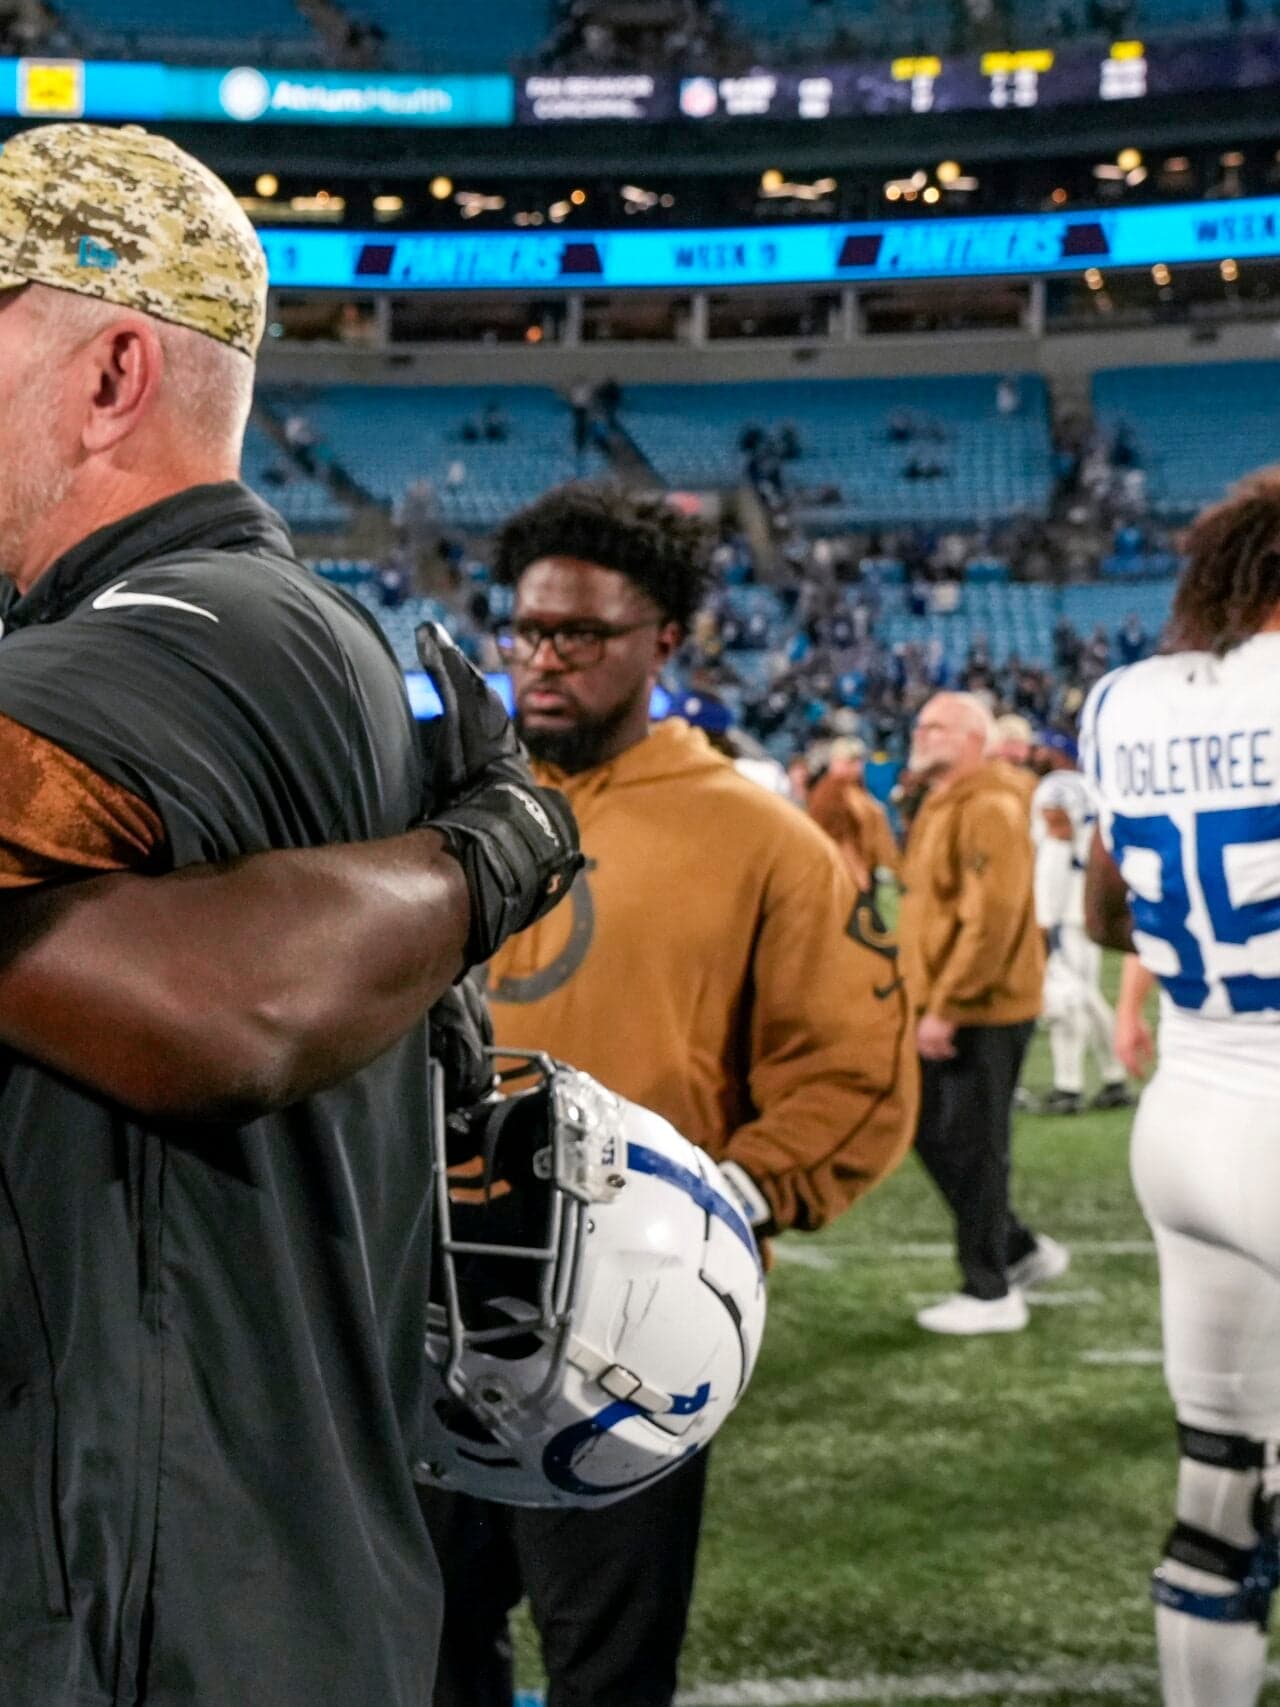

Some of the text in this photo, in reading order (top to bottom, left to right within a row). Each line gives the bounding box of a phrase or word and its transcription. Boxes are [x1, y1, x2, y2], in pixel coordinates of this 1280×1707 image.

[674, 243, 746, 270] WEEK
[883, 222, 1066, 272] PANTHERS
[1114, 729, 1274, 798] OGLETREE
